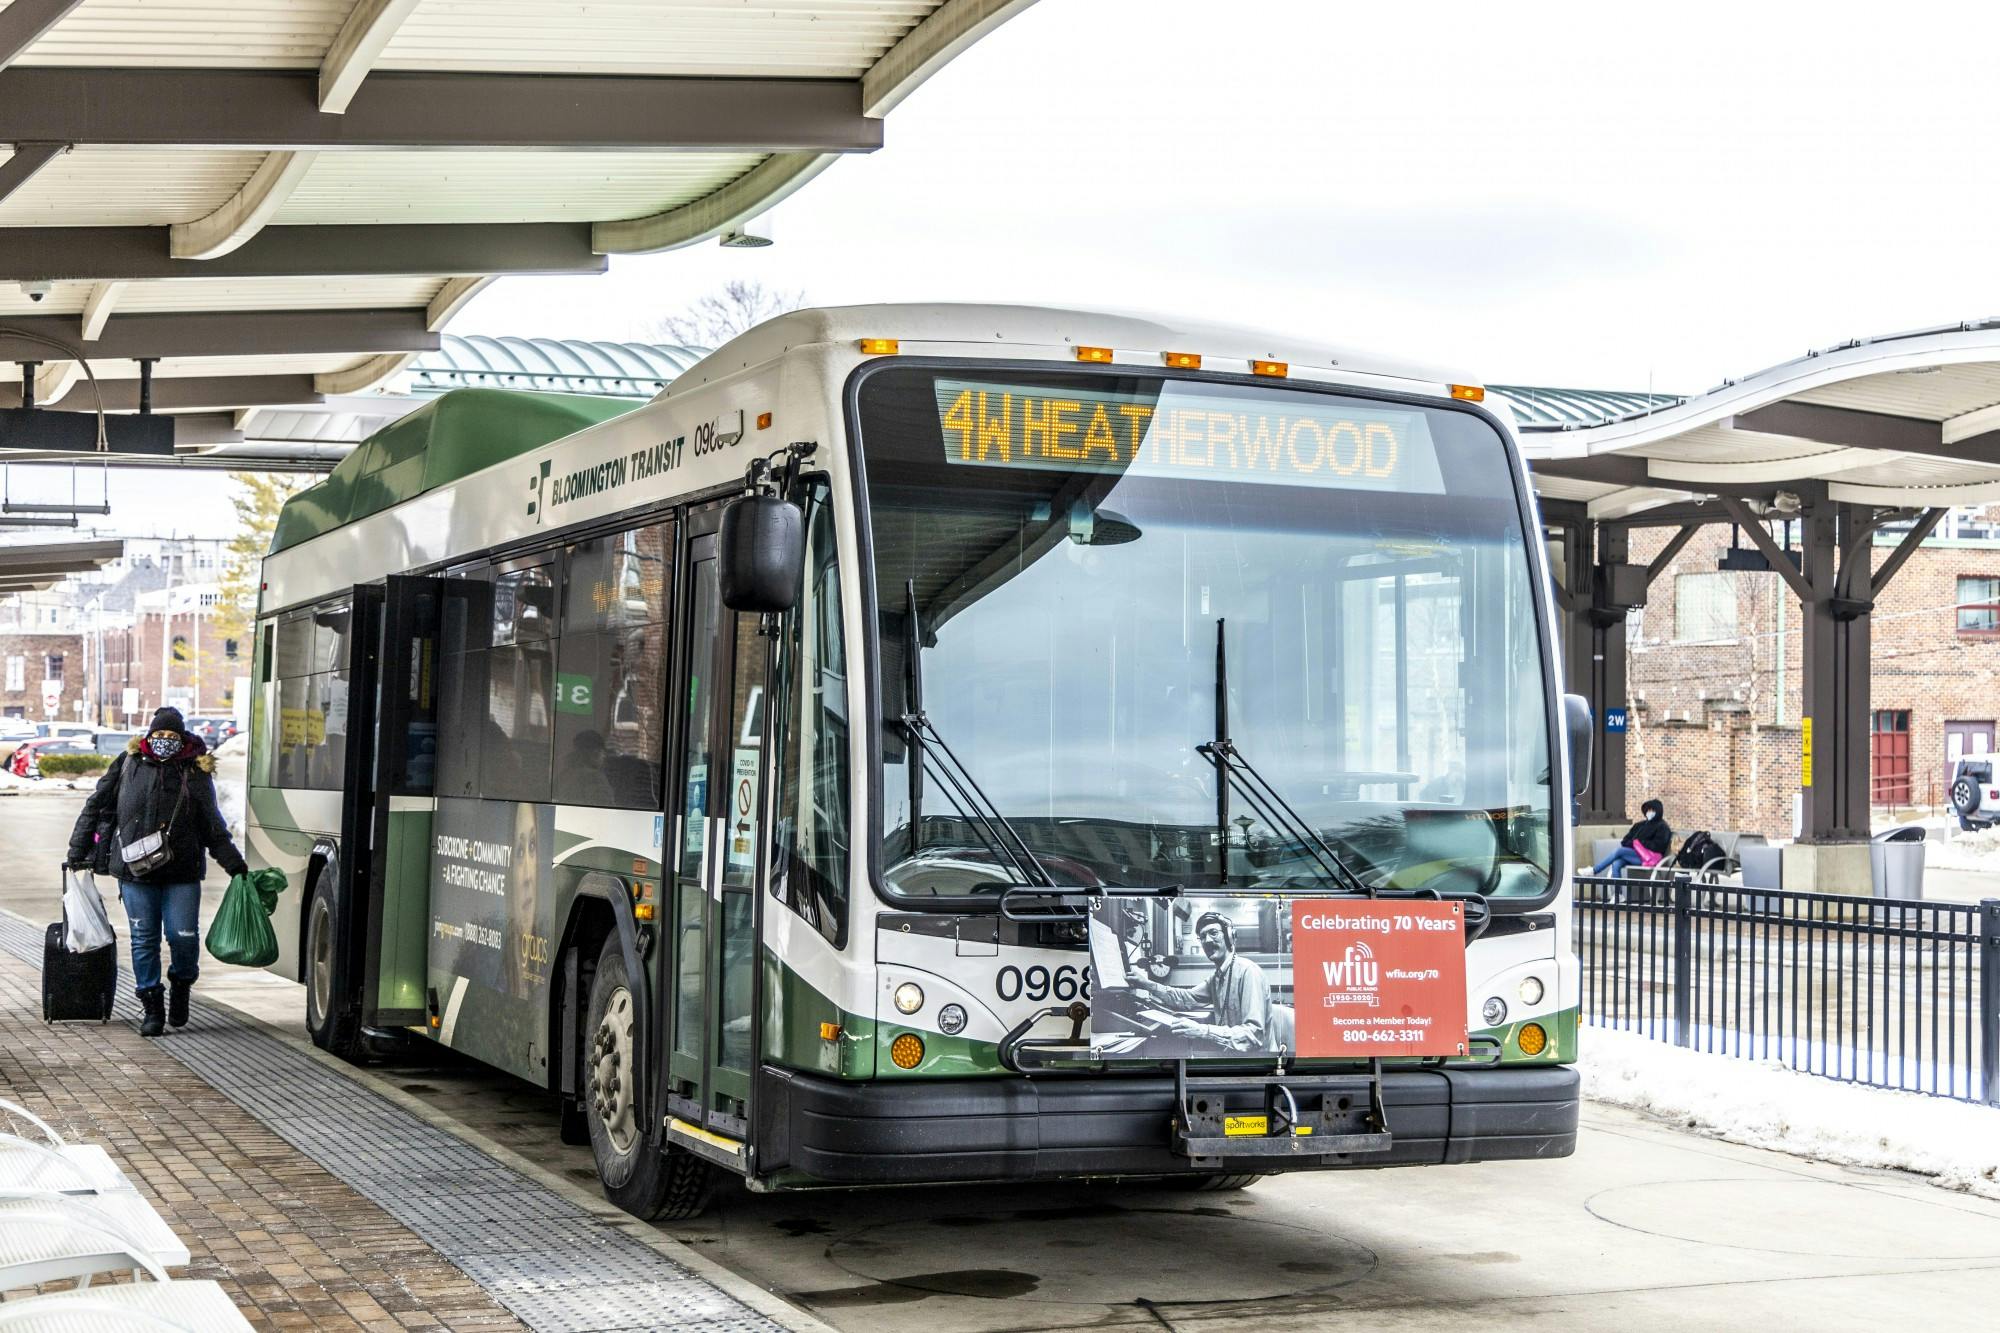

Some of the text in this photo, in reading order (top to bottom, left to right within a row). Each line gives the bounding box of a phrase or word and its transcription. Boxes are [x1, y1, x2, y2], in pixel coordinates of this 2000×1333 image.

[943, 389, 1398, 478] 4W HEATHERWOOD
[551, 436, 685, 507] BLOOMINGTON TRANSIT
[1607, 714, 1625, 727] 2W
[437, 835, 469, 860] SUBOXONE
[473, 840, 512, 867] COMMUNITY
[451, 865, 479, 891] FIGHTING
[478, 870, 506, 896] CHANCE
[1301, 915, 1457, 934] Celebrating 70 Years
[521, 933, 548, 971] groups
[1323, 946, 1378, 986] wfiu
[1385, 969, 1439, 981] wfiu.org/70
[1332, 1017, 1364, 1025] Become
[1373, 1017, 1405, 1025] Member
[1406, 1016, 1432, 1026] Today!
[1343, 1029, 1424, 1042] 800-662-3311
[1226, 1120, 1265, 1130] sportworks
